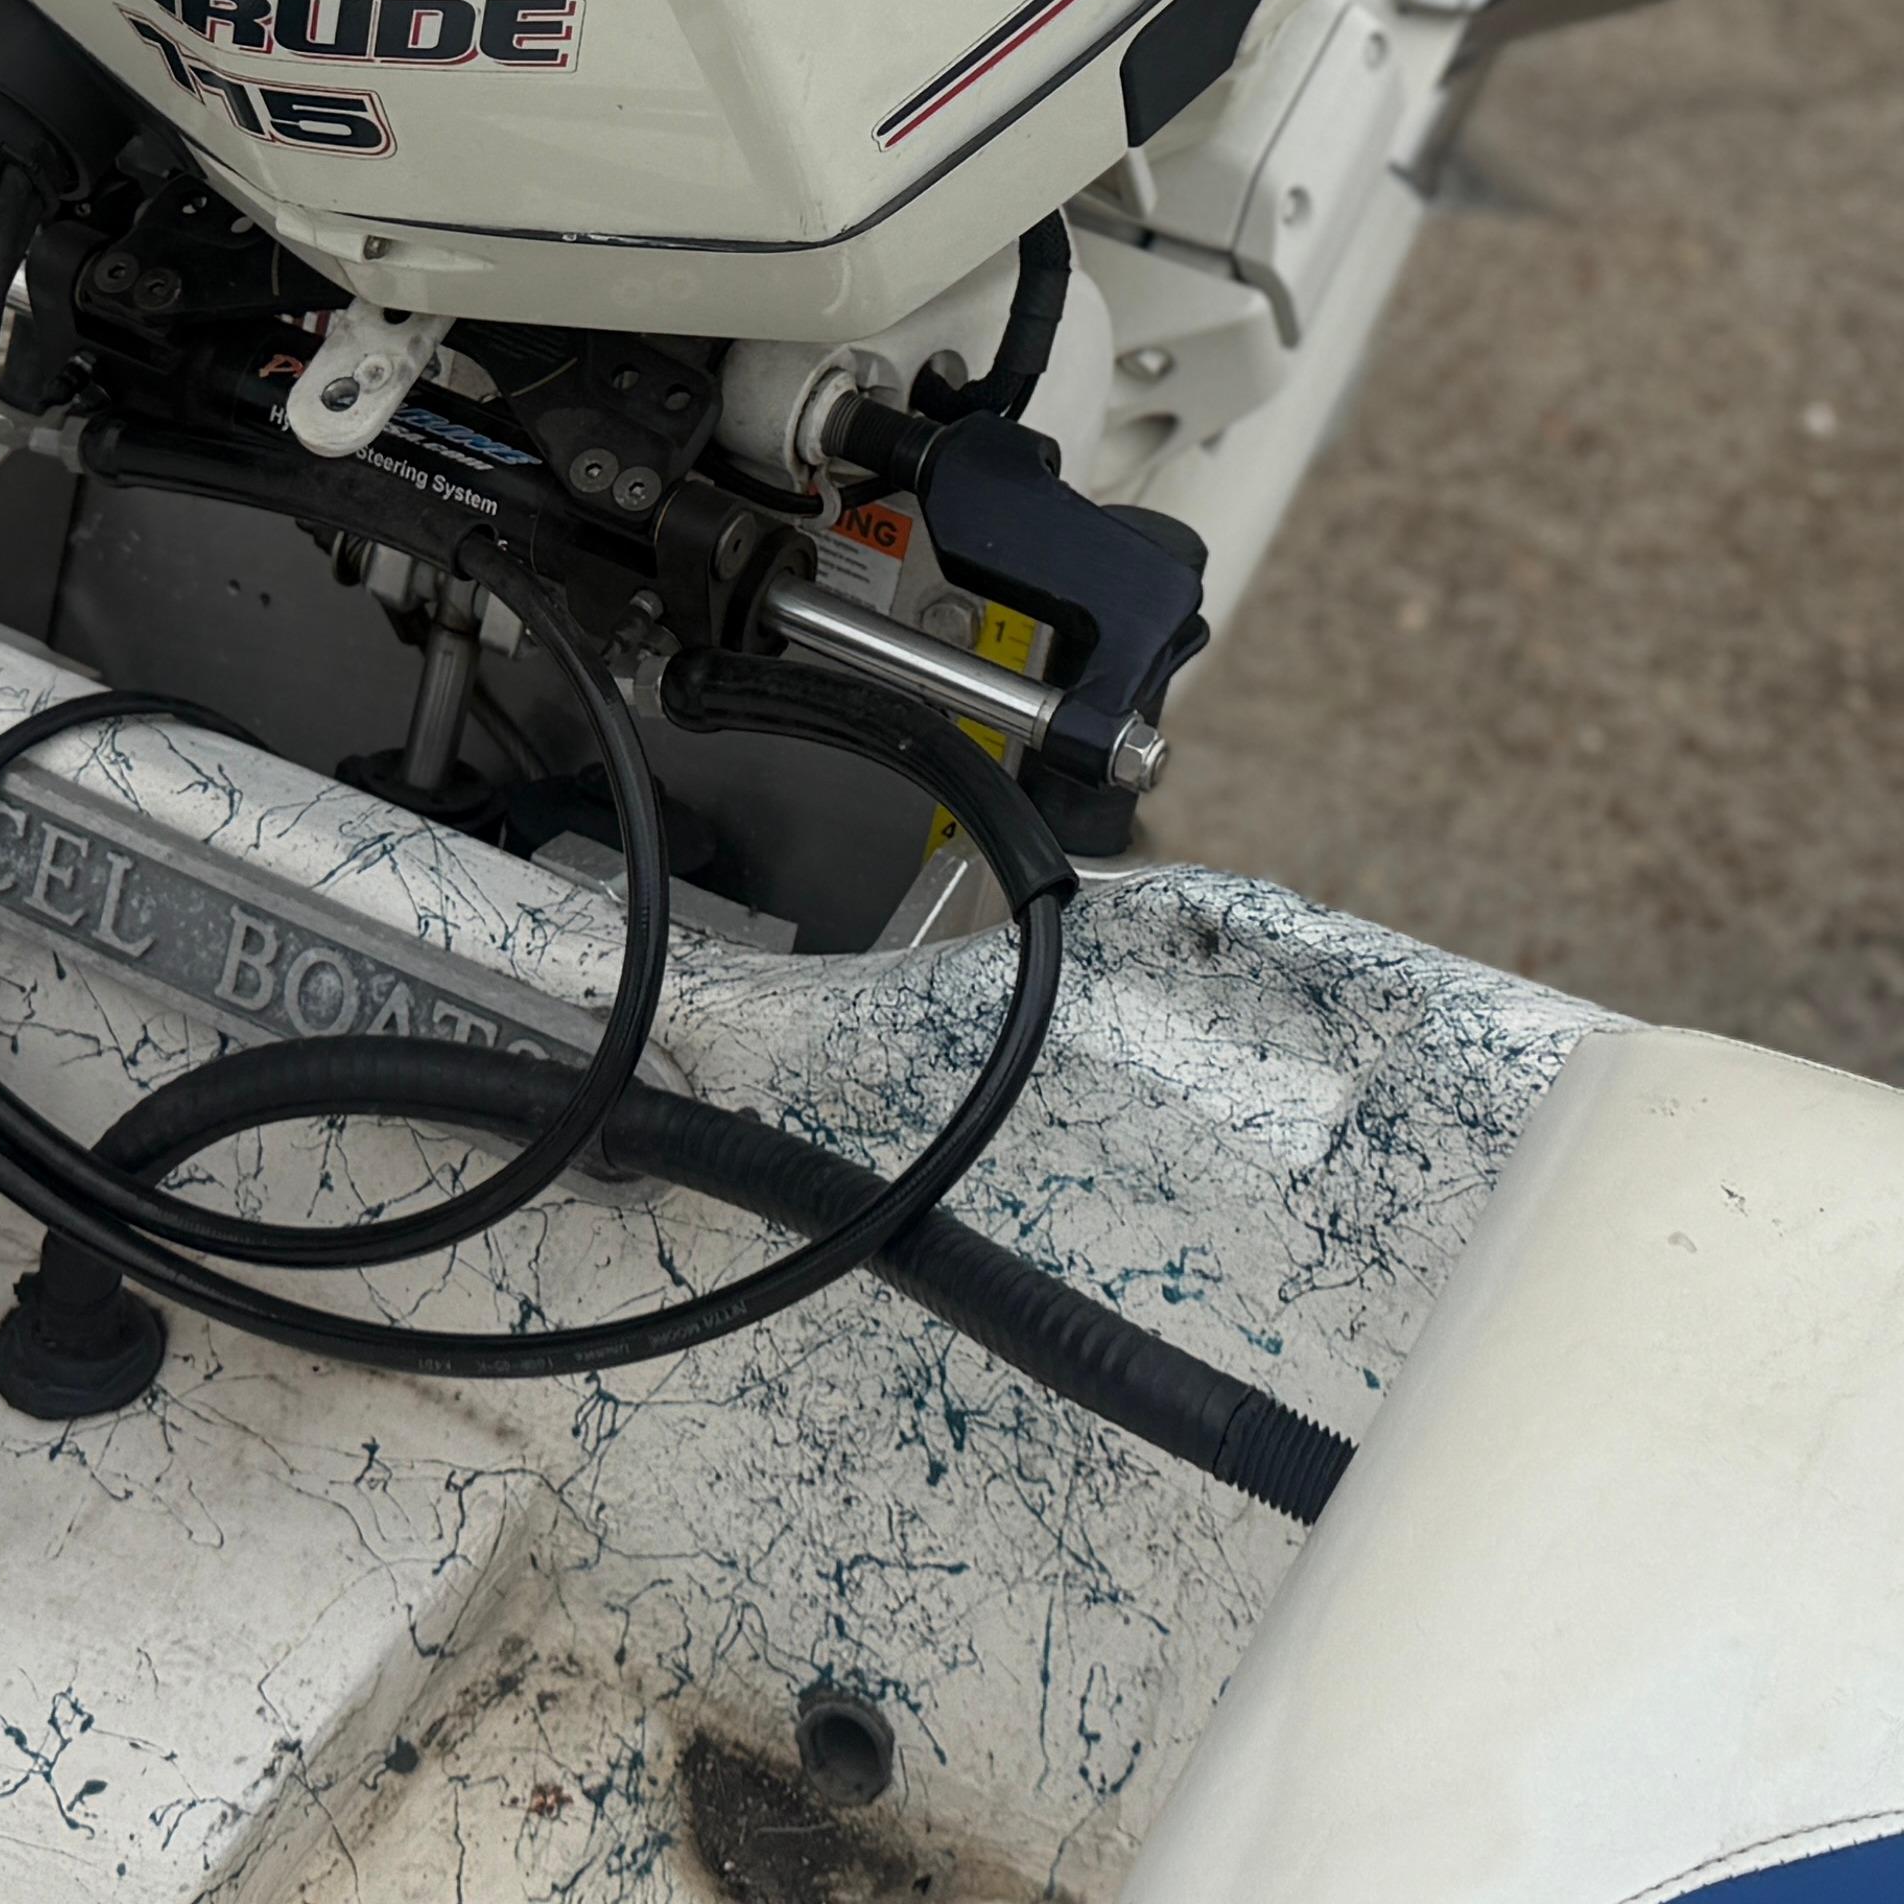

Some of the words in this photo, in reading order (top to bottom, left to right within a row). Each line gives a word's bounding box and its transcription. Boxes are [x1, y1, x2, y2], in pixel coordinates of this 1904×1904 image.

[117, 9, 387, 152] 115
[356, 446, 429, 490] Steering
[432, 474, 498, 517] System
